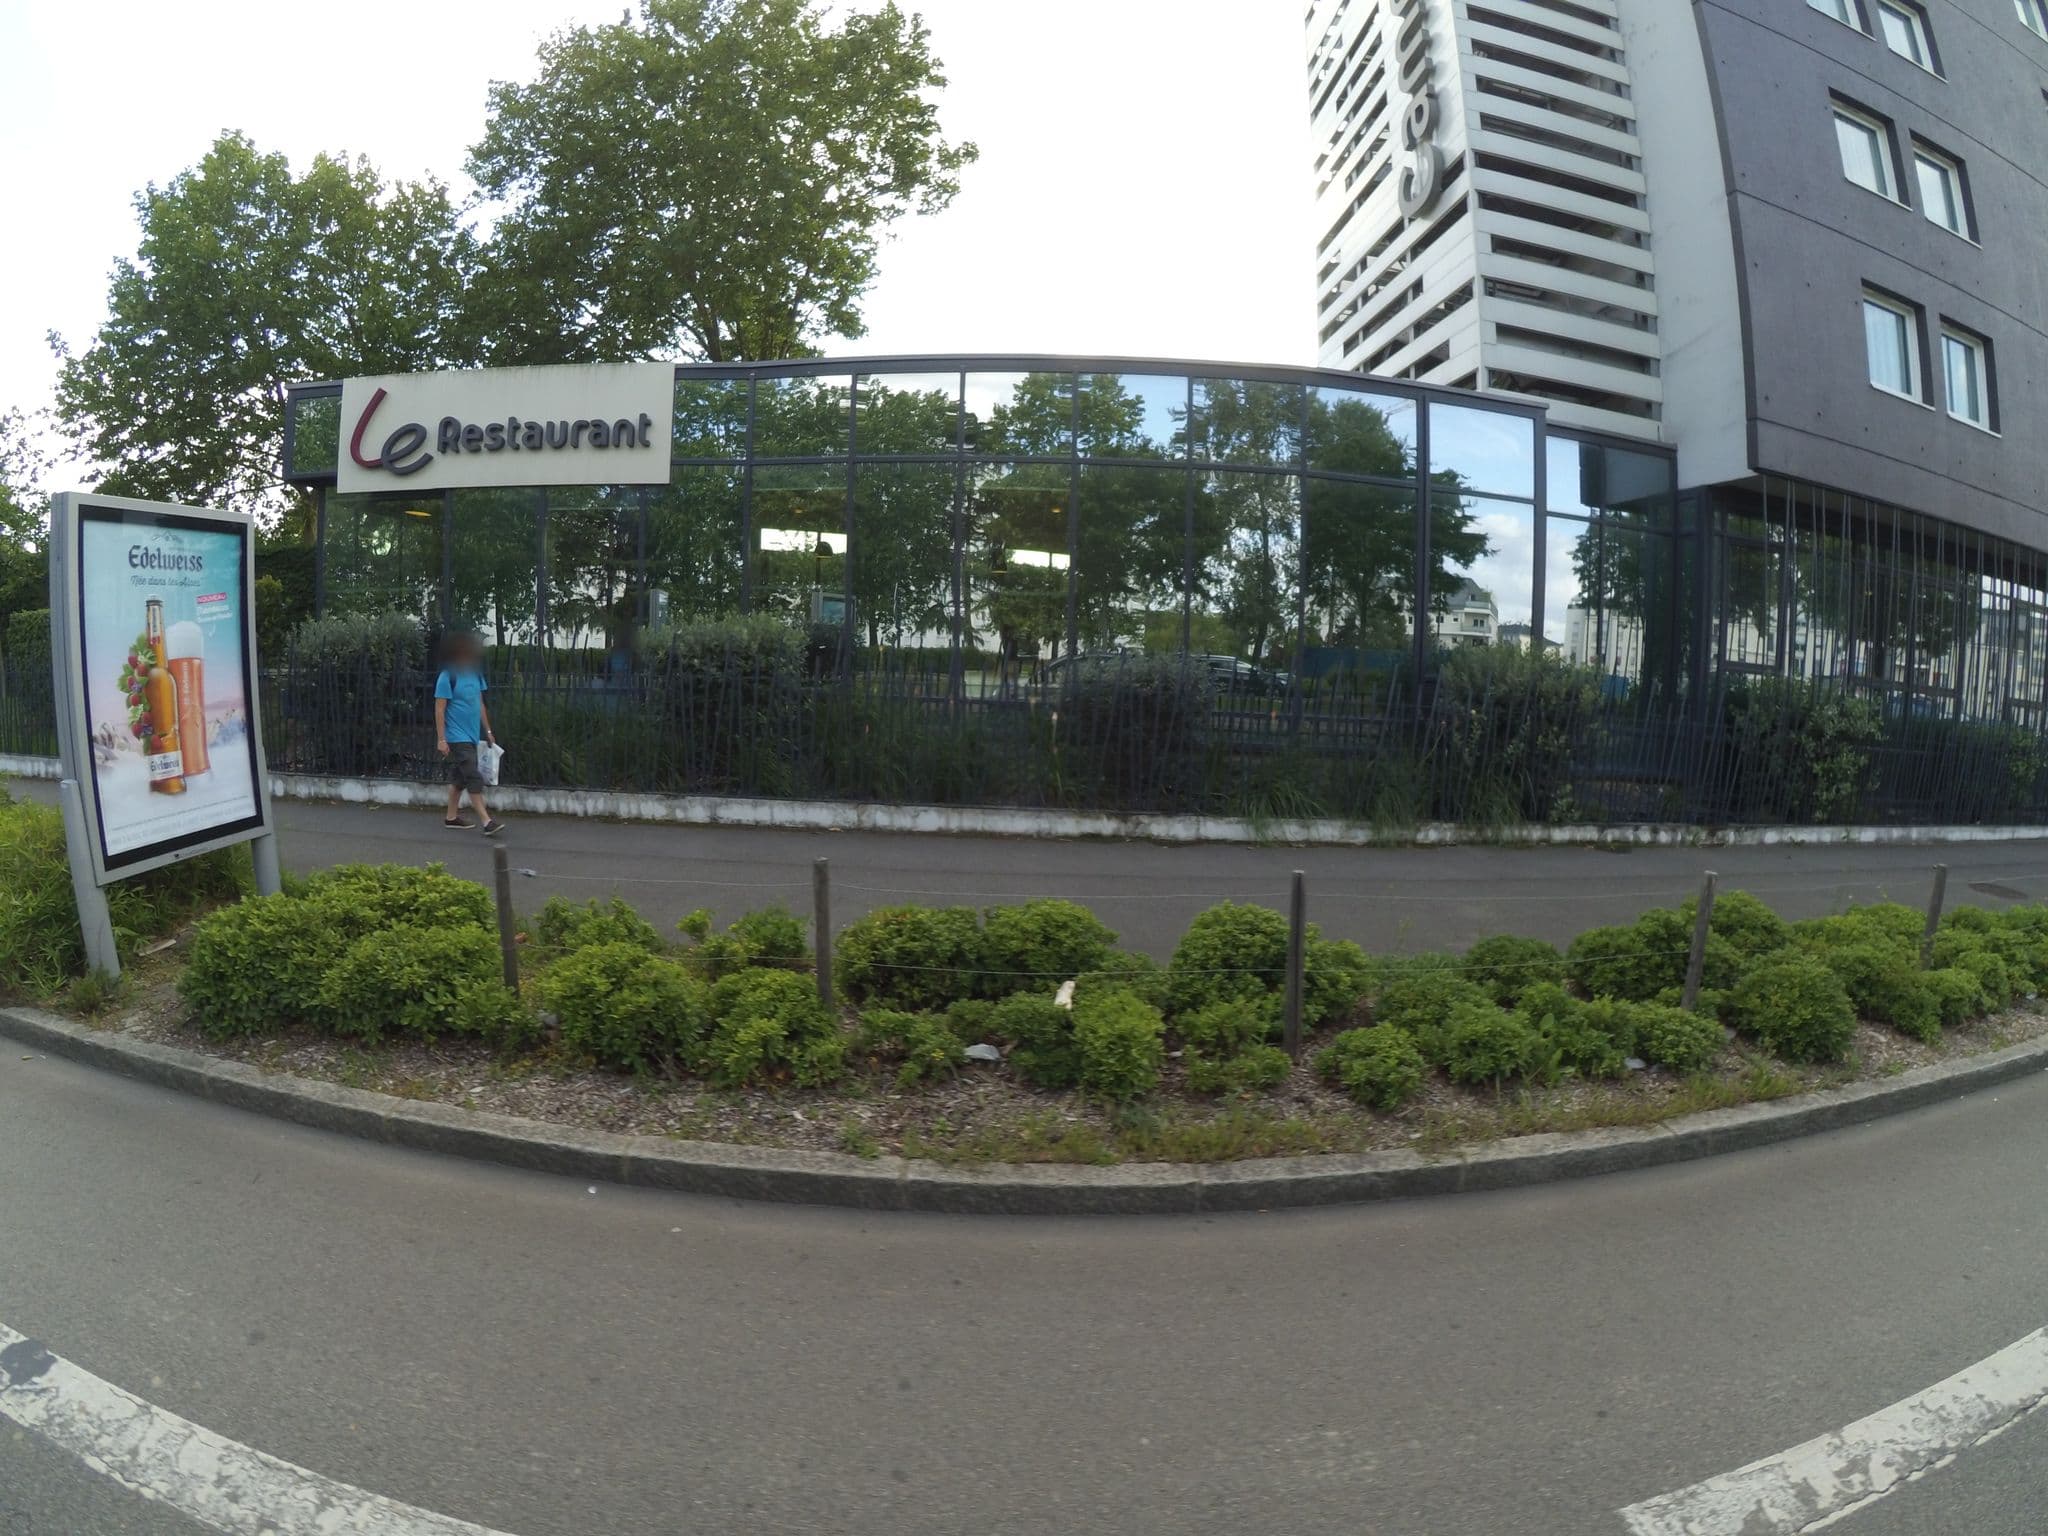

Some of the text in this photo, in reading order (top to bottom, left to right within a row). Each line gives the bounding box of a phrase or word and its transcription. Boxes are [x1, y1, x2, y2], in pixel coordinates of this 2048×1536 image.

[1390, 0, 1444, 219] Cam
[350, 387, 652, 476] Le Restaurant
[128, 545, 203, 572] Edelweiss
